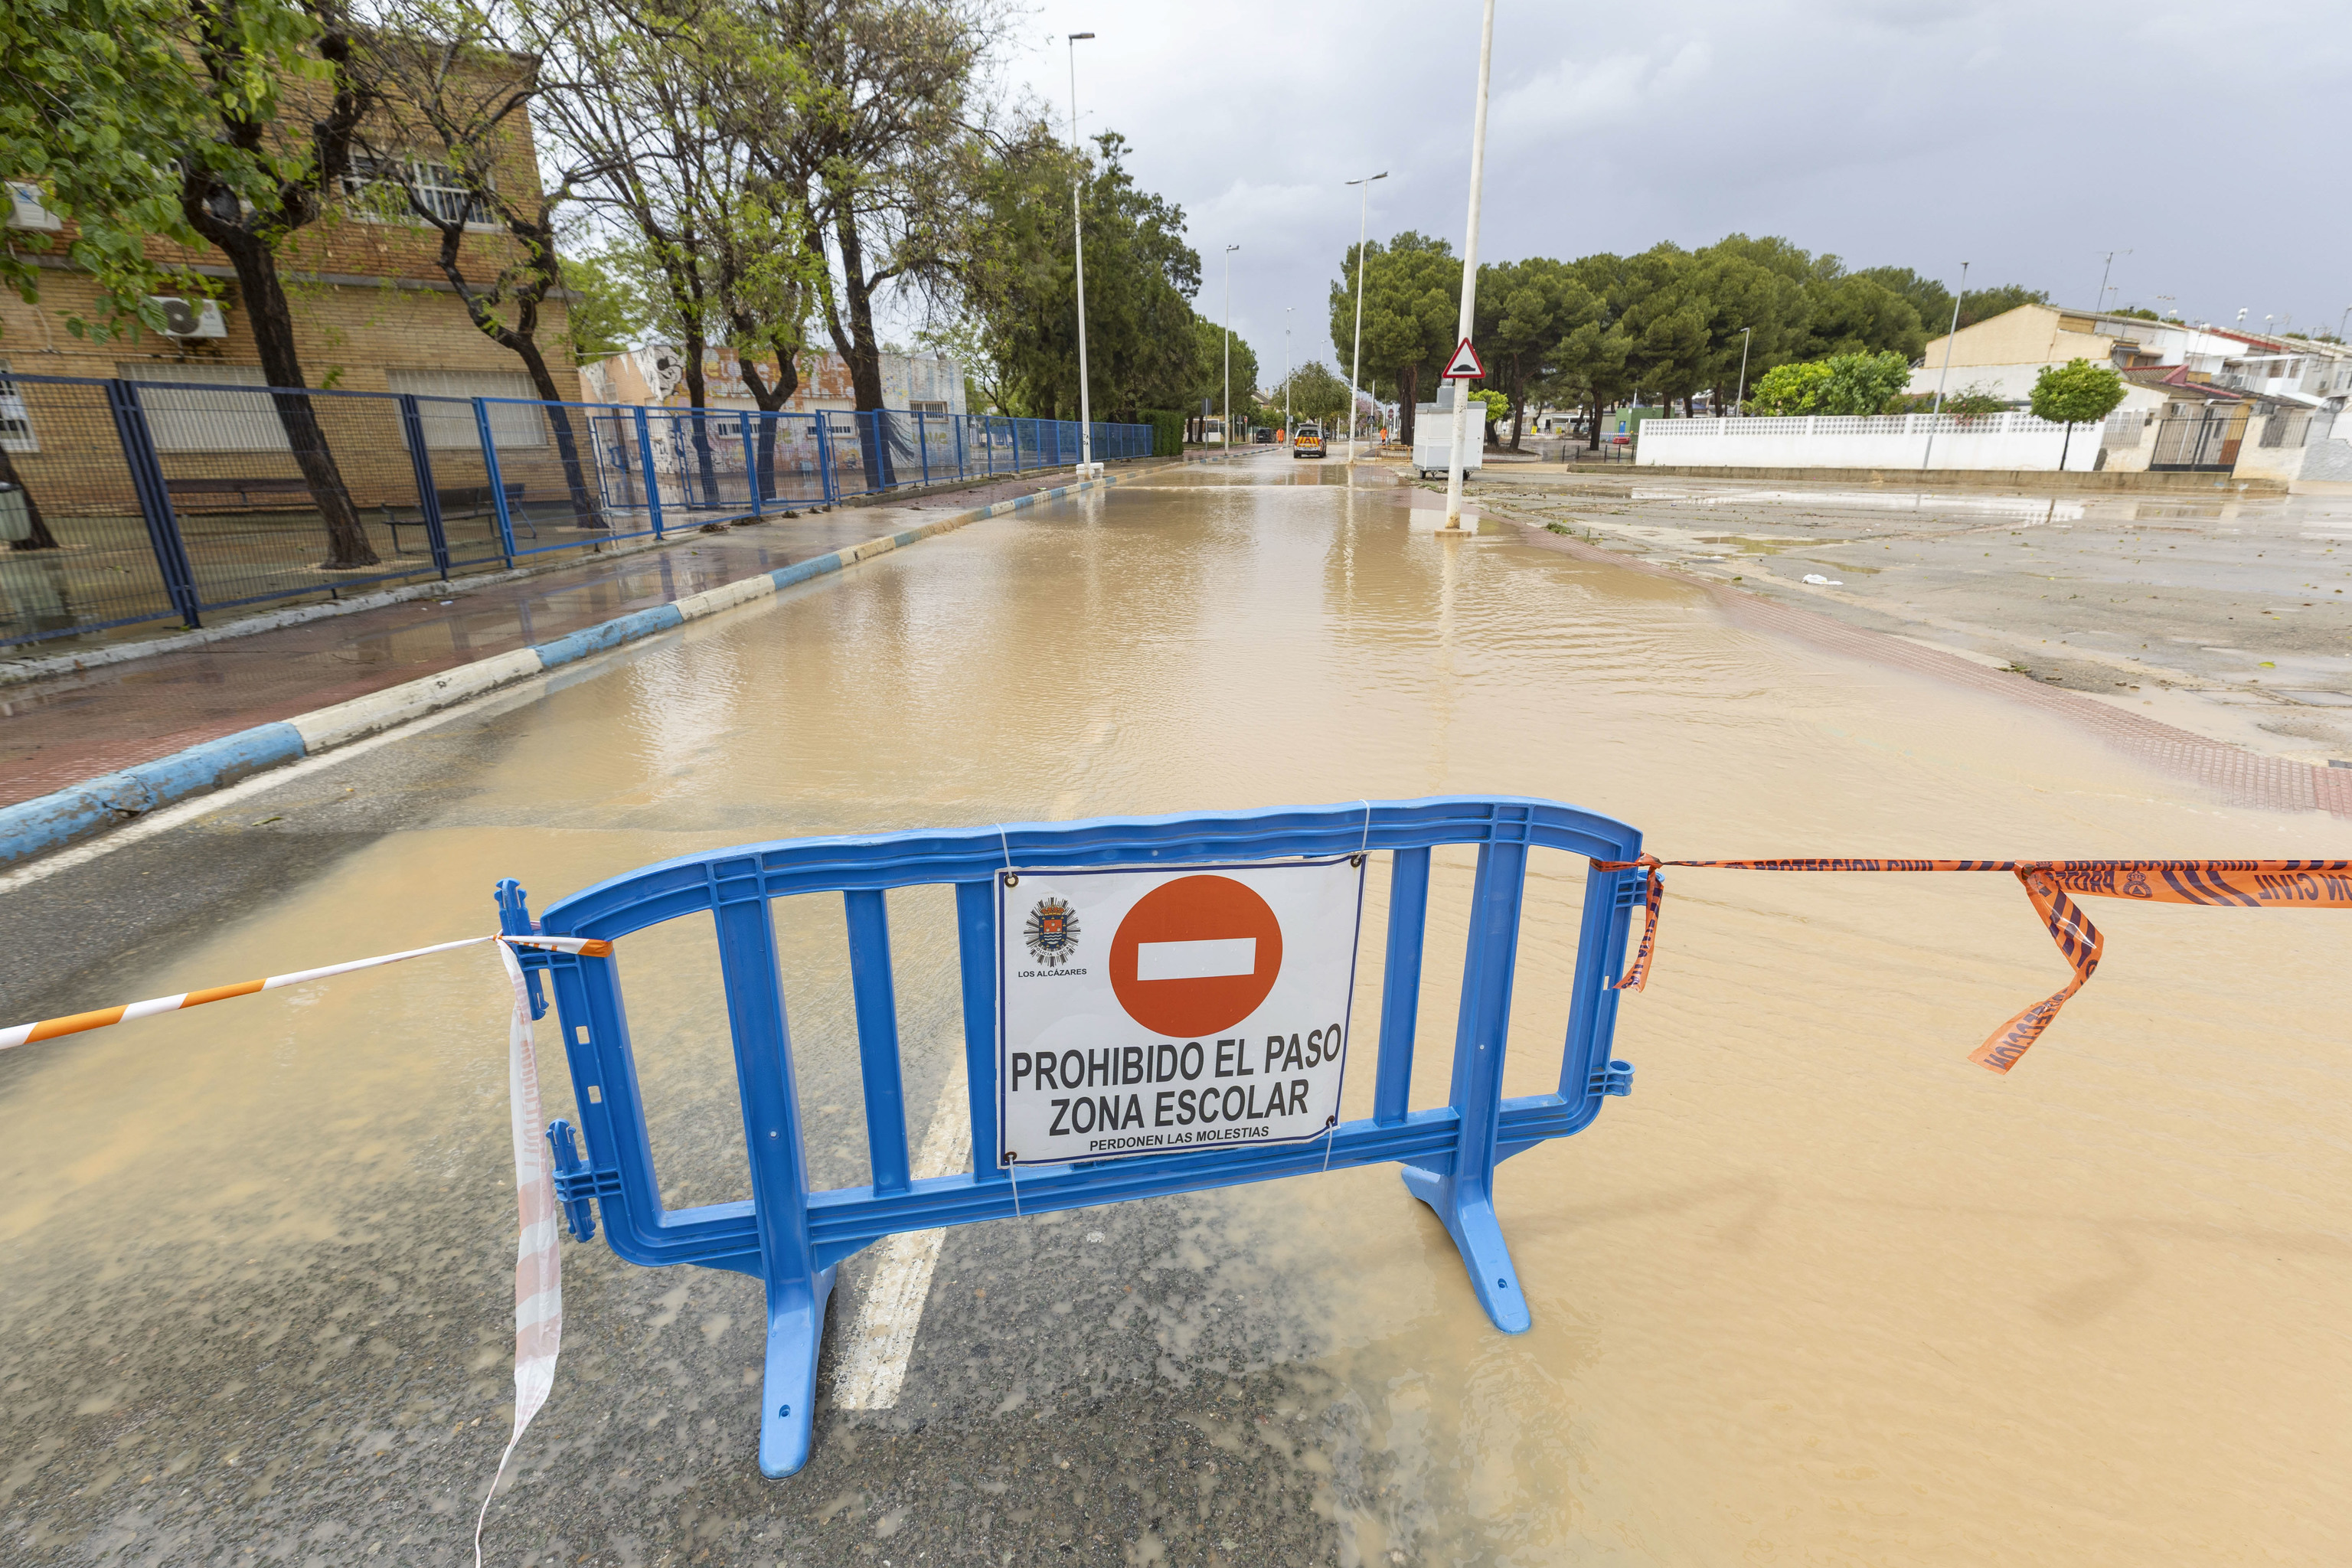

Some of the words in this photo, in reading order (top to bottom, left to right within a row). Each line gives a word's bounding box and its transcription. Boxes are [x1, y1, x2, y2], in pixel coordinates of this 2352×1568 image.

[1037, 969, 1087, 977] ALCÁZARES
[1011, 1042, 1204, 1092] PROHIBIDO
[1214, 1038, 1254, 1078] EL
[1264, 1023, 1341, 1074] PASO
[1049, 1094, 1145, 1137] ZONA
[1154, 1079, 1309, 1128] ESCOLAR
[1089, 1135, 1163, 1152] PERDONEN
[1167, 1132, 1193, 1145] LAS
[1196, 1126, 1269, 1142] MOLESTIAS
